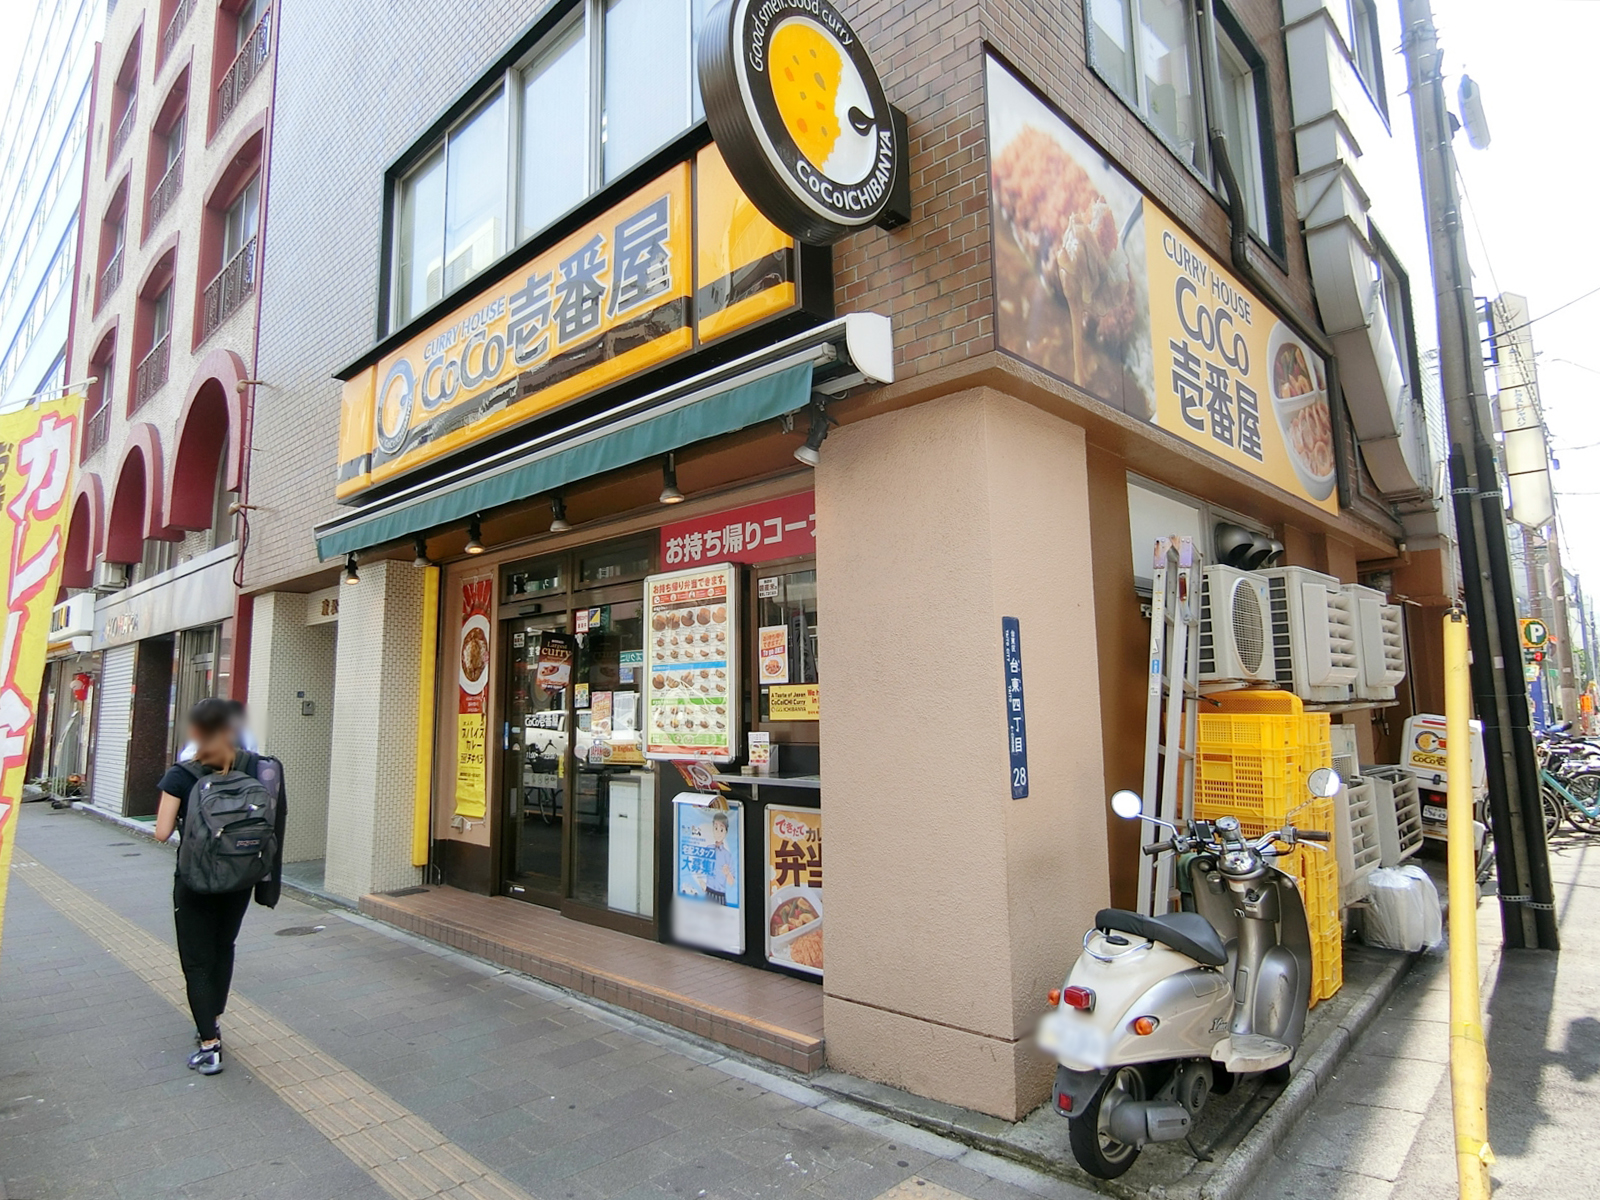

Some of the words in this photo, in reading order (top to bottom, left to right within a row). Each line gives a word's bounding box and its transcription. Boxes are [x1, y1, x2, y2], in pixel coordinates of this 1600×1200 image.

[749, 16, 765, 72] Good
[821, 11, 853, 45] curry
[796, 130, 893, 211] CoCoICHIBANYA
[1162, 230, 1209, 287] CURRY
[1210, 271, 1253, 326] HOUSE
[423, 325, 461, 361] CURRY
[462, 294, 506, 338] HOUSE
[1175, 275, 1250, 377] CoCo
[1169, 337, 1264, 463] 壱番屋
[541, 647, 571, 658] curry
[1530, 624, 1544, 642] P
[1013, 767, 1027, 787] 28
[775, 819, 804, 837] できたて
